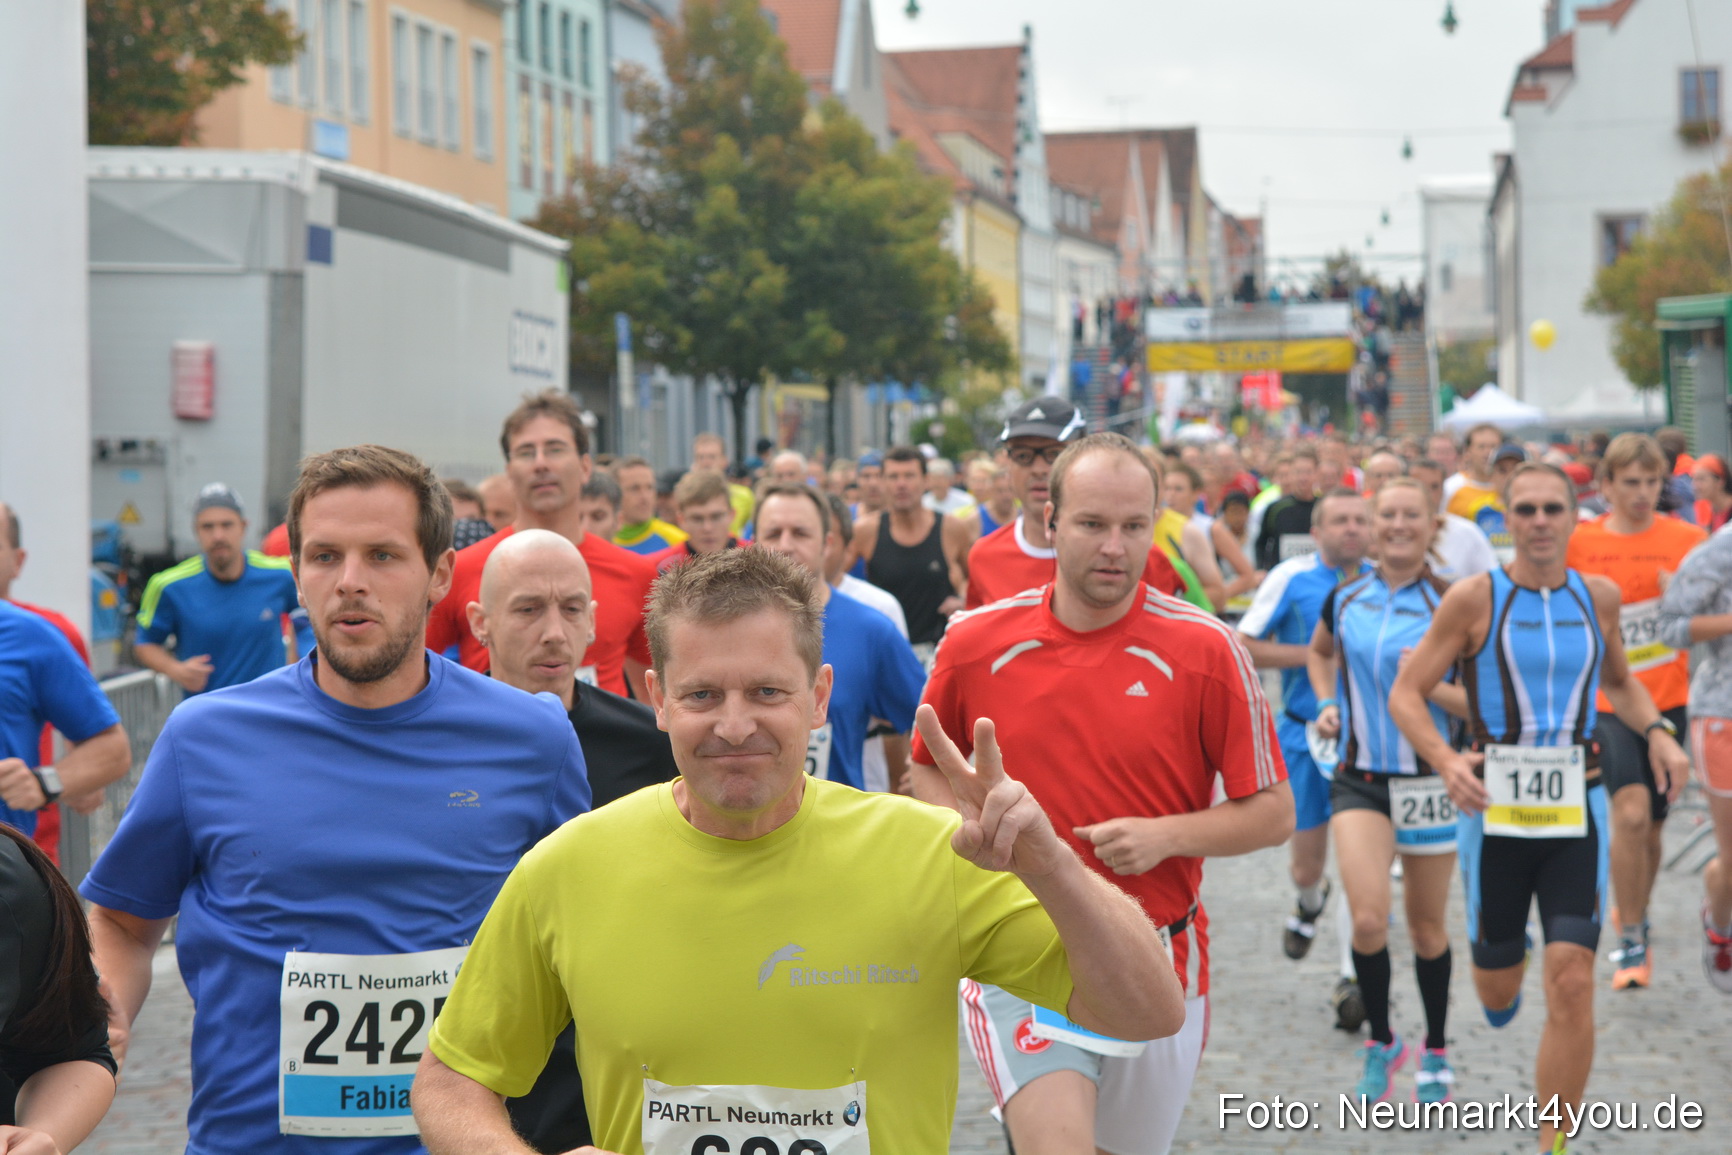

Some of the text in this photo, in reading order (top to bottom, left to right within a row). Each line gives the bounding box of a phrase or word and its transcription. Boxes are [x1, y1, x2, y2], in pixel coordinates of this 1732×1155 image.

[1216, 349, 1284, 364] START
[1506, 769, 1563, 801] 140
[1510, 808, 1558, 823] Thomas
[287, 970, 449, 990] PARTL Neumarkt
[790, 963, 920, 988] Ritschi Ritsch
[289, 1060, 297, 1072] B
[648, 1100, 721, 1123] PARTL
[727, 1106, 834, 1127] Neumarkt
